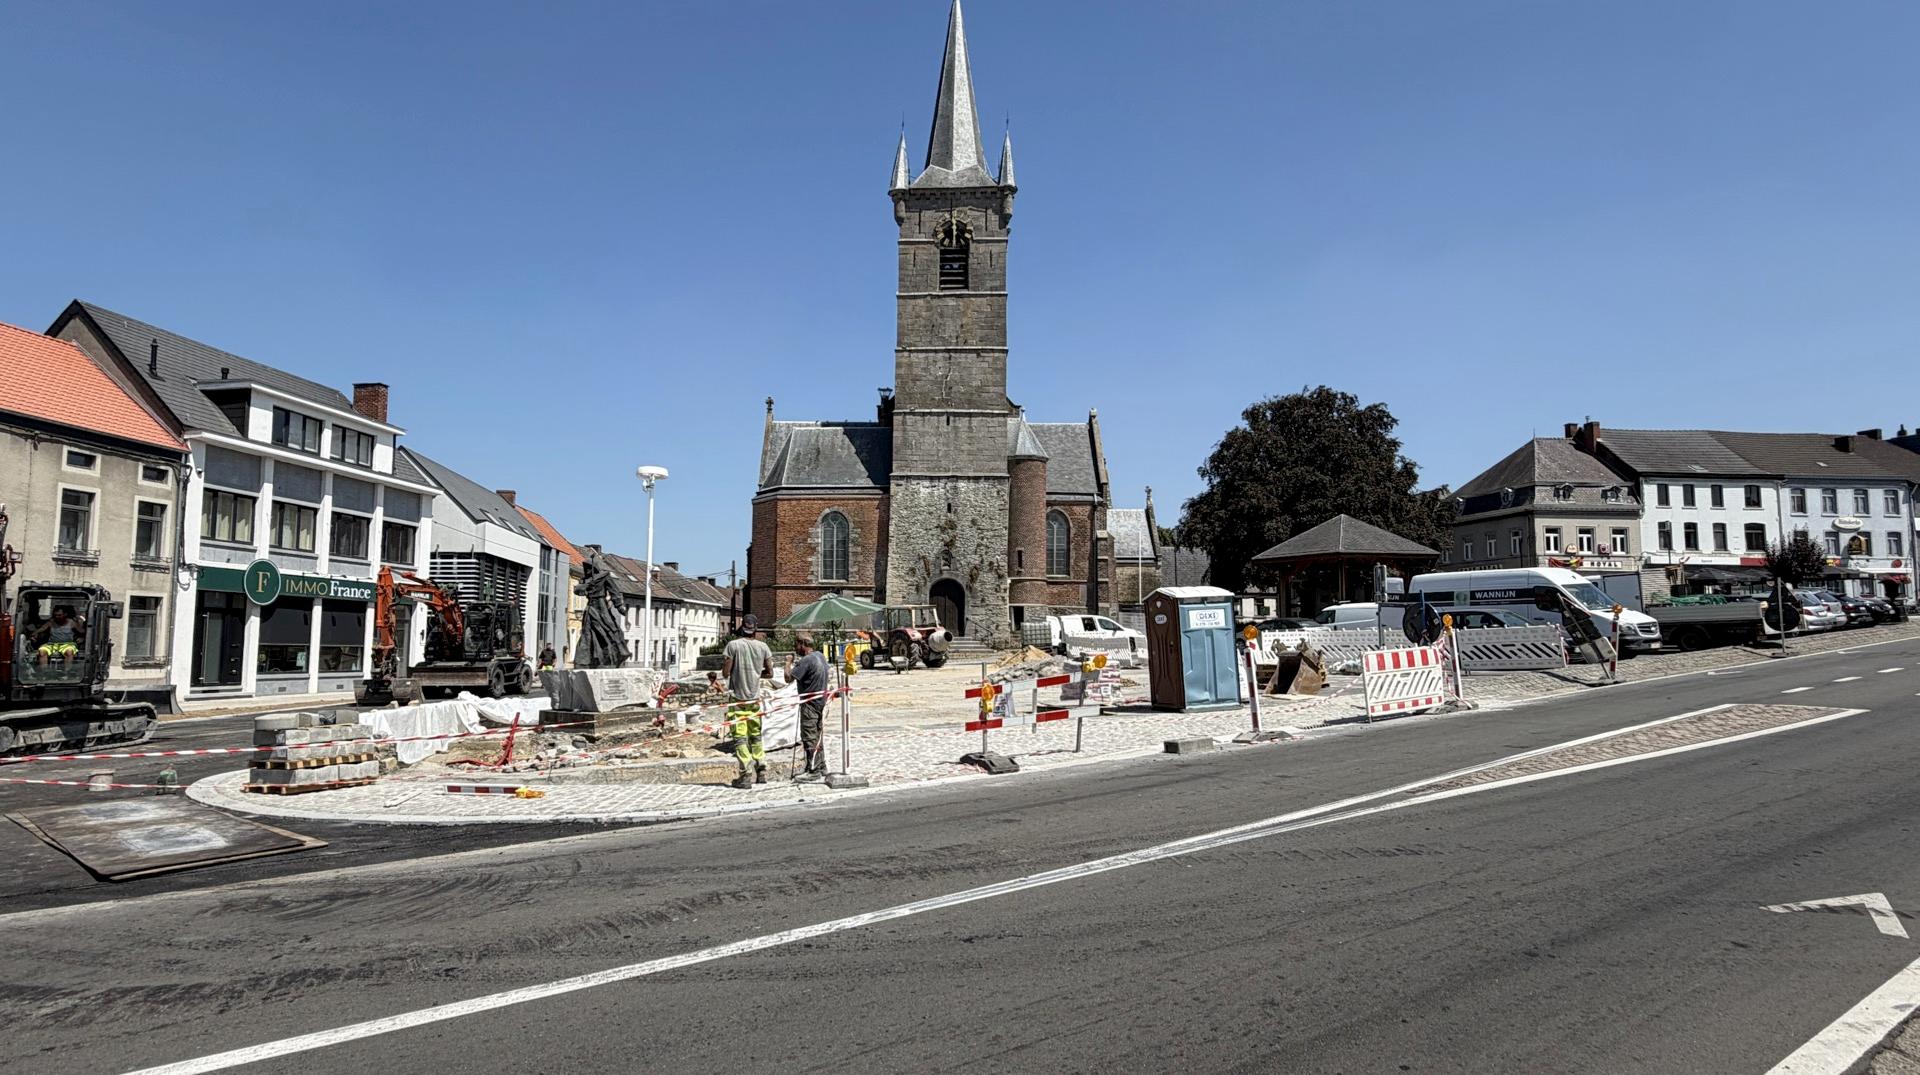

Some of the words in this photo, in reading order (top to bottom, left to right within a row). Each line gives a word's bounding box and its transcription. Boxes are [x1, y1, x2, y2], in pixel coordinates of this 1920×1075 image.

[256, 571, 271, 593] F
[285, 579, 328, 596] IMMO
[329, 580, 371, 599] France
[1474, 590, 1516, 599] WANNIJN
